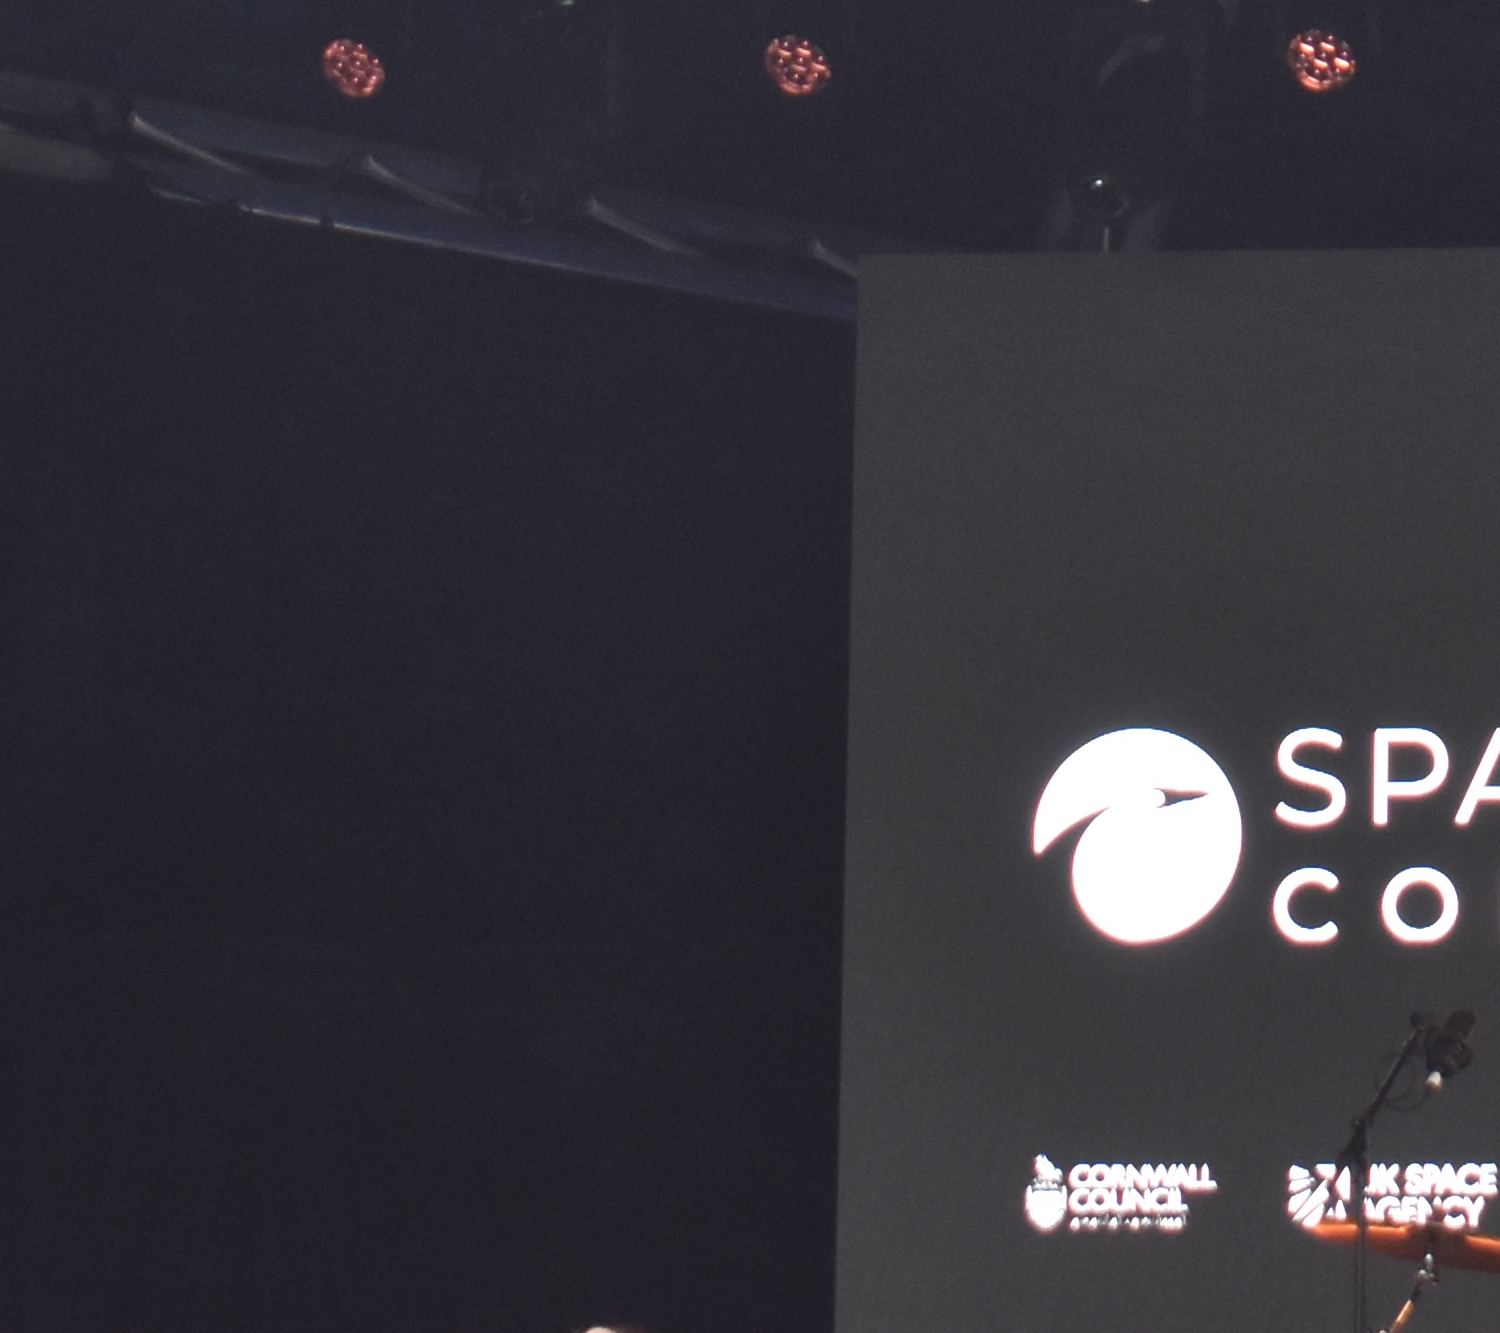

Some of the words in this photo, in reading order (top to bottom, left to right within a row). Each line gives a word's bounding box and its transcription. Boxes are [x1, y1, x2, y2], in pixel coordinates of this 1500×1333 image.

[1068, 1162, 1218, 1191] CORNWALL
[1404, 1162, 1498, 1196] SPACE
[1068, 1188, 1189, 1215] COUNCIL
